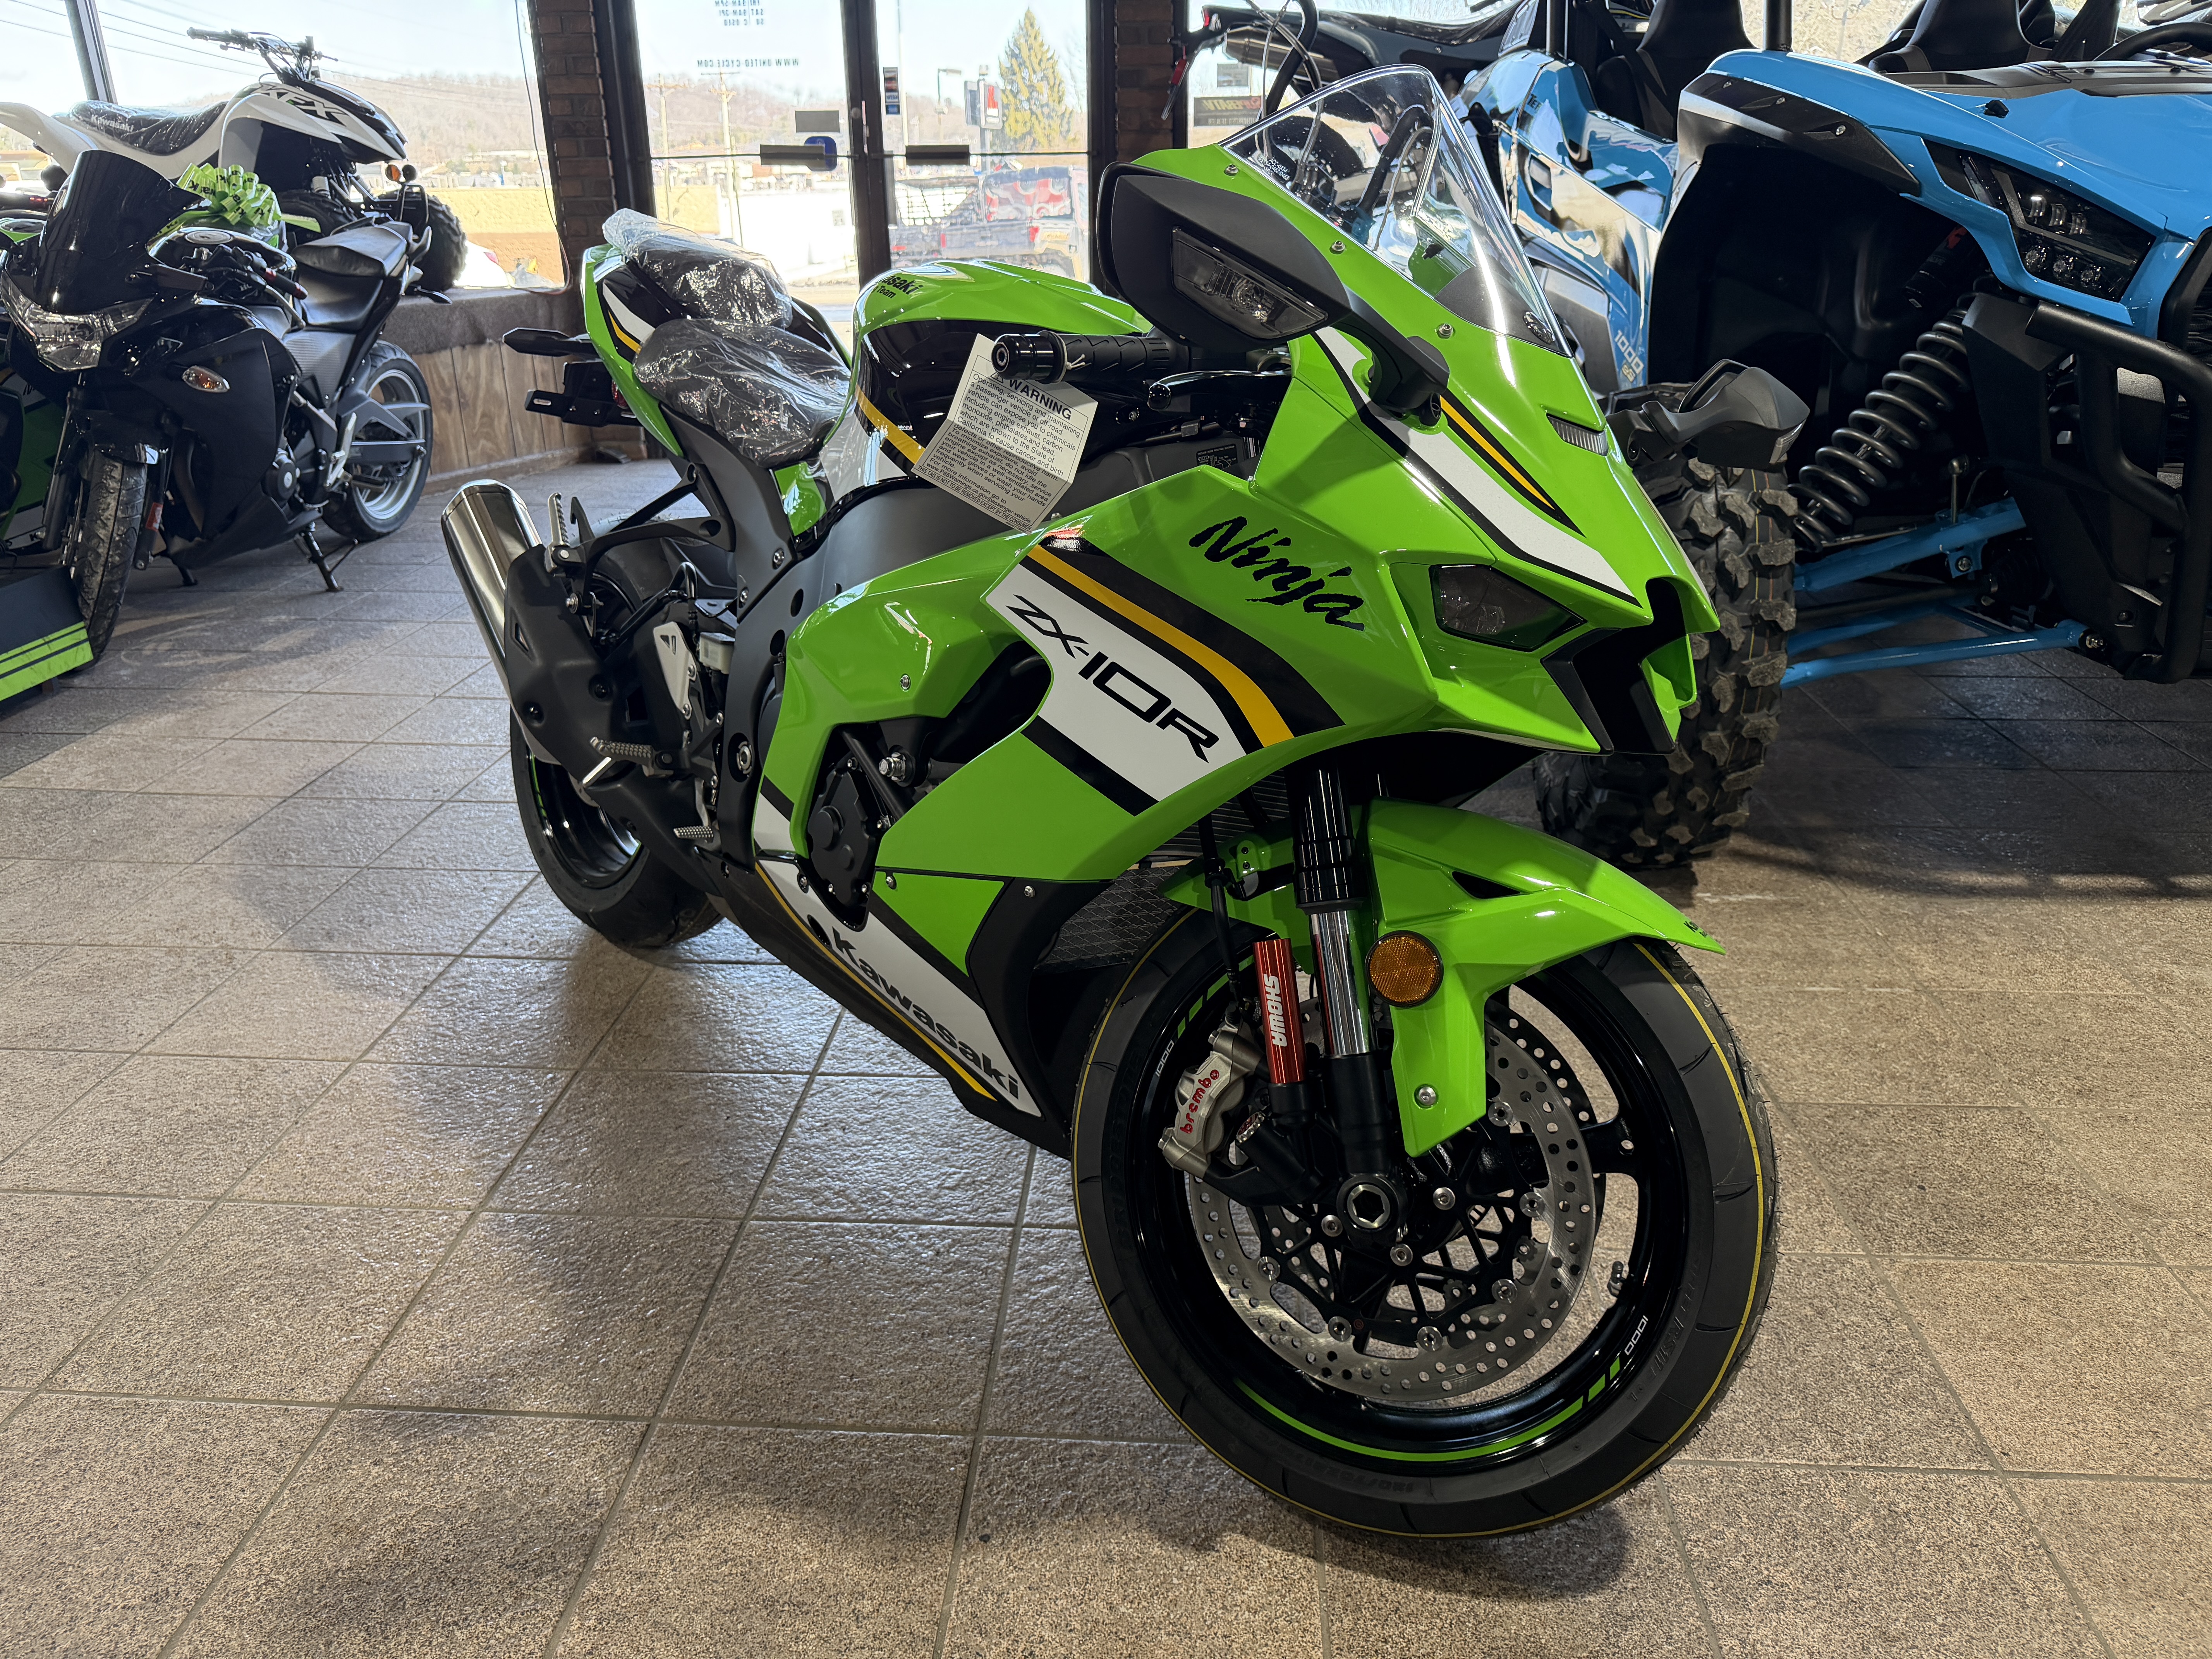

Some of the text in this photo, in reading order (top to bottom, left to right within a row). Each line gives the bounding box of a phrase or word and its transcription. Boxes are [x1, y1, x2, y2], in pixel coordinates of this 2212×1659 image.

[91, 114, 134, 132] Kawasaki
[877, 285, 896, 299] Team
[880, 275, 924, 295] asaki
[1614, 329, 1644, 374] 1000
[965, 394, 1063, 452] including engine exhaust, carbon
[968, 388, 990, 403] vehicle
[991, 401, 1003, 410] can
[1004, 408, 1026, 422] expose
[1026, 421, 1038, 430] you
[1046, 431, 1076, 451] chemicals
[973, 373, 1080, 438] Operating, servicing and maintaining
[975, 384, 1009, 405] passenger
[1010, 402, 1031, 417] vehicle
[1040, 419, 1063, 435] off-road
[1009, 379, 1072, 419] WARNING
[948, 432, 977, 451] breathing
[976, 448, 1003, 466] exhaust,
[1014, 467, 1025, 476] not
[1025, 473, 1036, 482] idle
[954, 424, 977, 438] defects
[986, 441, 1003, 451] other
[1003, 450, 1041, 473] reproductive
[1041, 469, 1058, 481] harm.
[957, 416, 1063, 476] California to cause cancer and birth
[960, 410, 978, 423] which
[979, 420, 990, 429] are
[991, 425, 1011, 440] known
[1020, 441, 1030, 450] the
[1031, 447, 1047, 459] State
[960, 433, 989, 450] minimize
[987, 449, 1018, 467] exposure,
[1020, 465, 1038, 476] avoid
[962, 403, 994, 424] monoxide,
[1041, 443, 1055, 459] lead,
[929, 457, 941, 466] For
[941, 465, 957, 475] more
[958, 473, 991, 495] information
[933, 454, 955, 469] vehicle.
[936, 449, 1025, 501] frequently when servicing your
[938, 444, 951, 453] and
[952, 452, 968, 462] wear
[967, 461, 988, 475] gloves
[997, 477, 1012, 488] wash
[1012, 487, 1027, 496] your
[1027, 494, 1046, 507] hands
[941, 441, 957, 451] your
[957, 448, 979, 462] vehicle
[992, 467, 1035, 494] well-ventilated
[1034, 493, 1048, 502] area
[945, 437, 966, 450] engine
[965, 448, 988, 464] except
[995, 465, 1028, 486] necessary,
[1030, 484, 1052, 497] service
[918, 465, 928, 473] THIS
[961, 489, 981, 503] REMOVED
[980, 500, 997, 511] EXCEPT
[1009, 517, 1032, 531] CONSUMER
[1188, 515, 1364, 631] Ninja
[1005, 594, 1220, 763] ZX-10R
[832, 926, 1019, 1099] Kawasaki
[1264, 974, 1288, 1047] SHOWA
[1155, 1040, 1175, 1077] 1000
[1180, 1069, 1220, 1133] brembo
[1625, 1315, 1649, 1356] 1000
